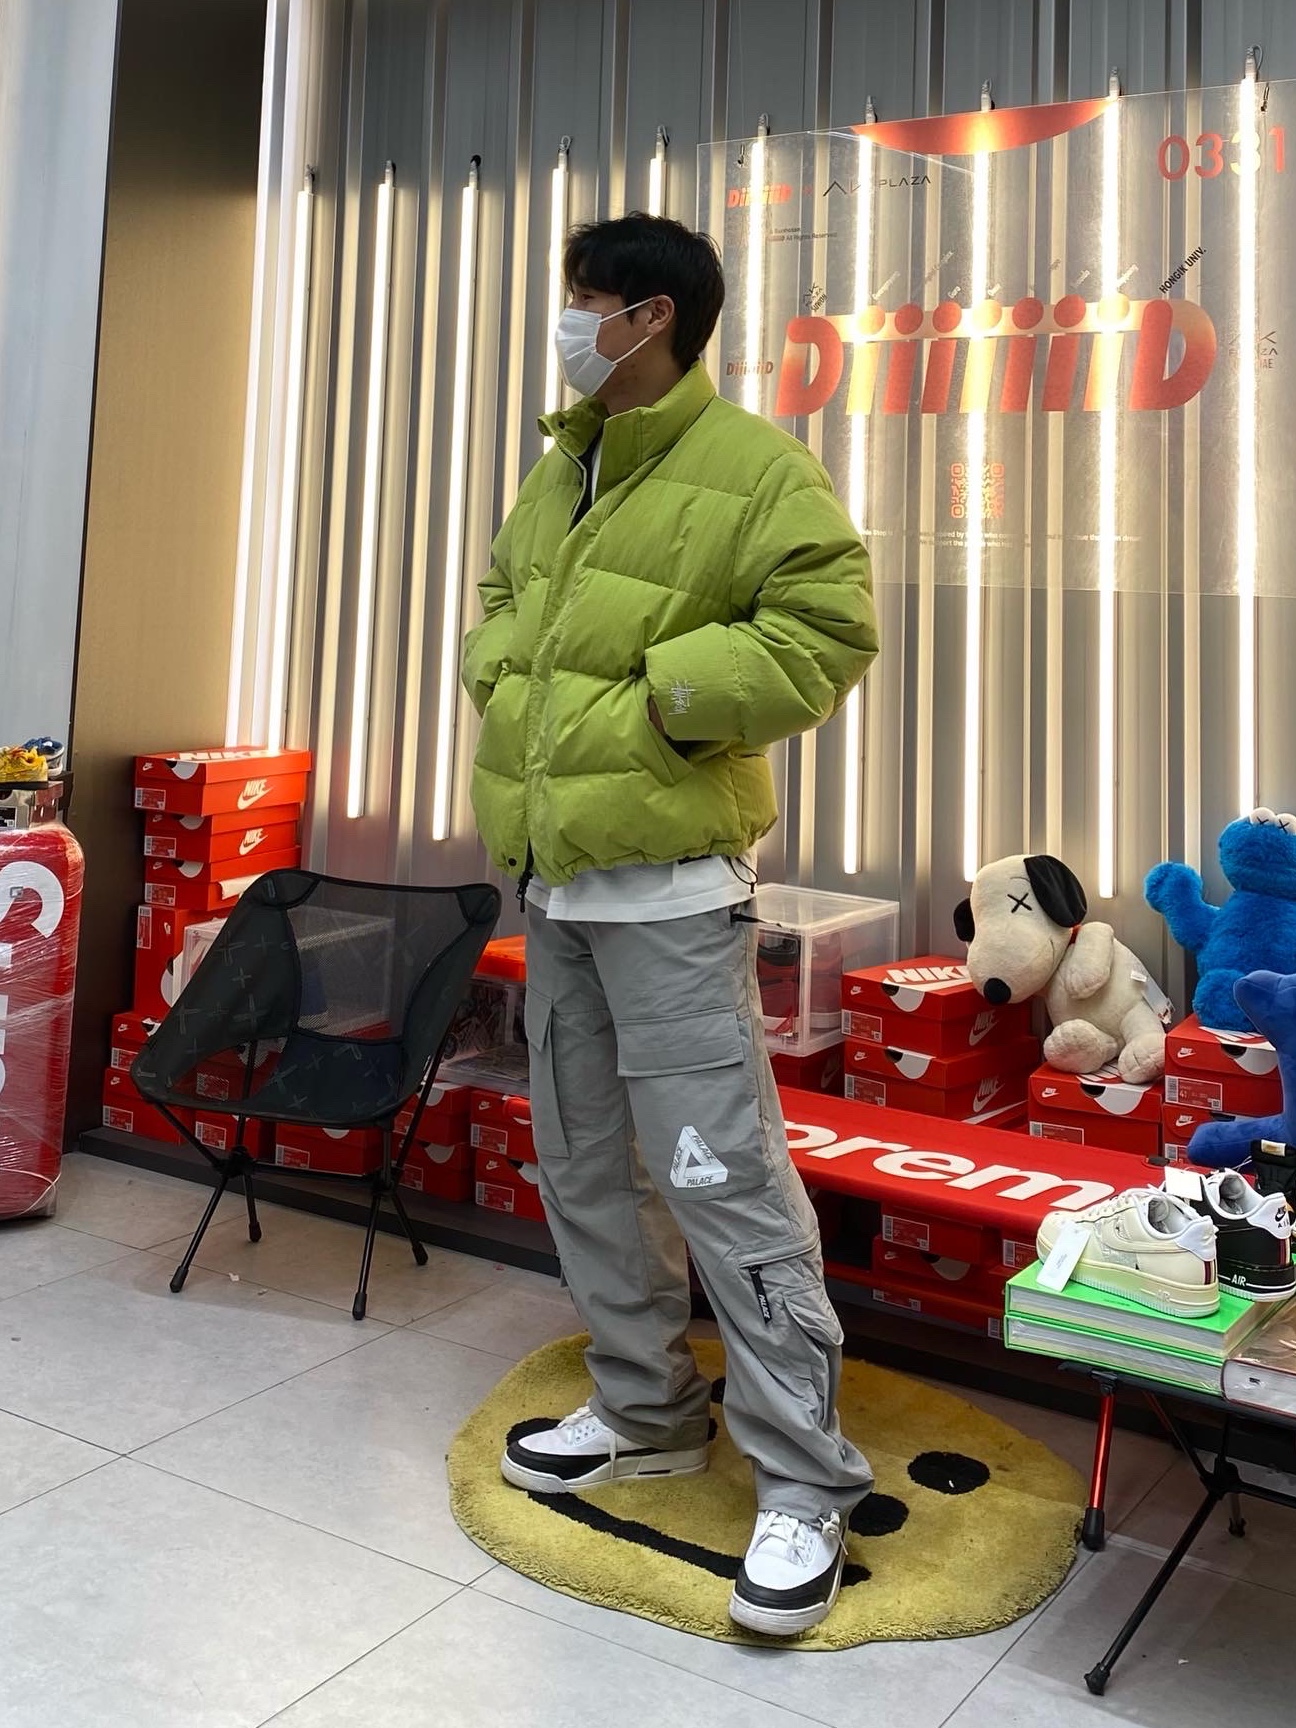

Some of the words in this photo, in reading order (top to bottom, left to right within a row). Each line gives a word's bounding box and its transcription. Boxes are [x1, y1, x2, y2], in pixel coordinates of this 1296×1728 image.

[1158, 264, 1189, 294] HONGIK
[1184, 246, 1207, 267] UNIV.
[243, 779, 268, 797] NIKE
[244, 828, 264, 846] NIKE
[974, 1009, 997, 1031] NIKE
[978, 1075, 1000, 1097] NIKE
[686, 1175, 714, 1187] PALACE
[1231, 1273, 1247, 1287] AIR
